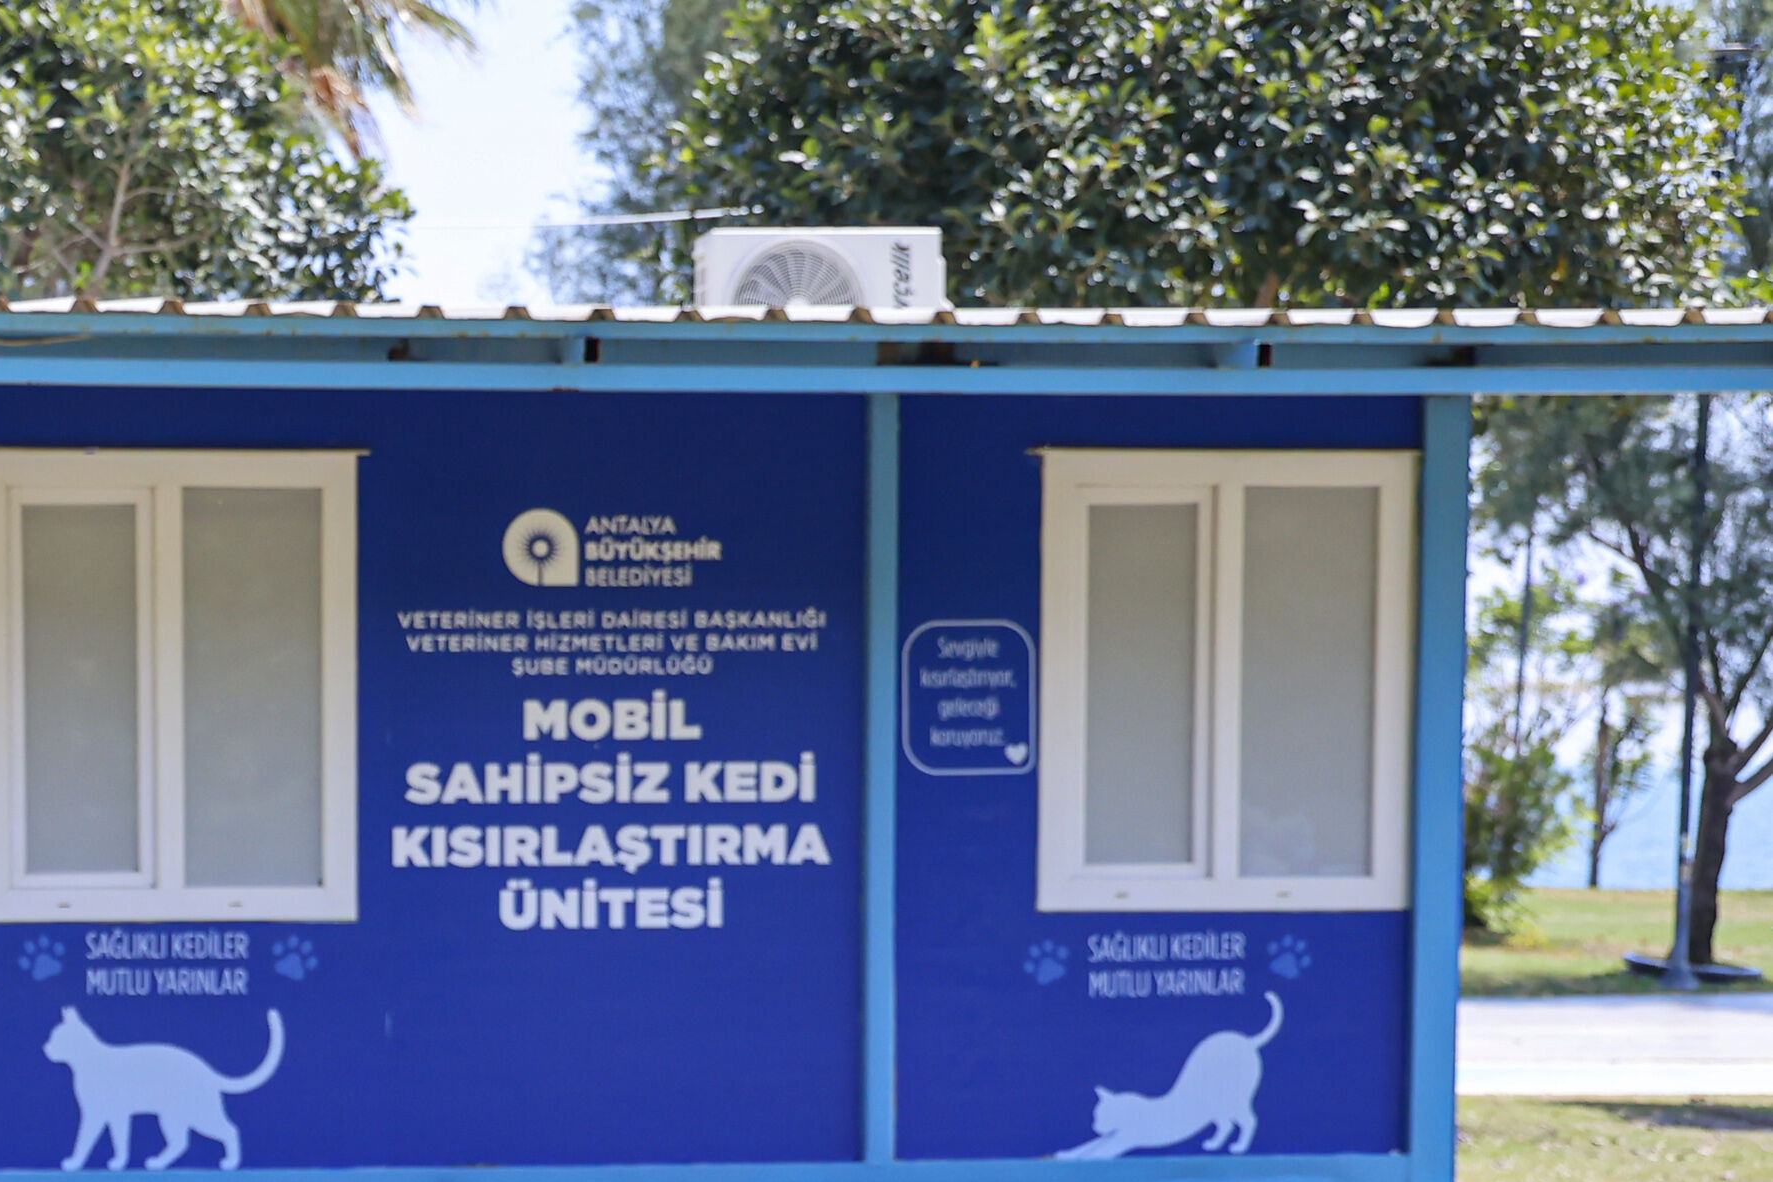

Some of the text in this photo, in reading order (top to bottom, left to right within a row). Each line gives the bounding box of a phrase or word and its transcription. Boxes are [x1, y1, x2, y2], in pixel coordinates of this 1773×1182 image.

[585, 515, 676, 535] ANTALYA
[585, 536, 722, 563] BÜYÜKŞEHİR
[585, 563, 693, 586] BELEDİYESİ
[397, 606, 827, 631] VETERİNER İŞLERİ DAİRESİ BAŞKANLIĞI
[406, 631, 819, 652] VETERİNER HİZMETLERİ VE BAKIM EVİ
[511, 653, 715, 678] ŞUBE MÜDÜRLÜĞÜ
[523, 689, 702, 740] MOBİL
[404, 751, 818, 805] SAHİPSİZ KEDİ
[391, 824, 830, 875] KISIRLAŞTIRMA
[498, 877, 724, 931] ÜNİTESİ
[85, 927, 249, 960] SAĞLIKLI KEDİLER
[1087, 929, 1246, 963] SAĞLIKLI KEDİLER
[86, 967, 249, 995] MUTLU YARINLAR
[1087, 967, 1246, 998] MUTLU YARINLAR
